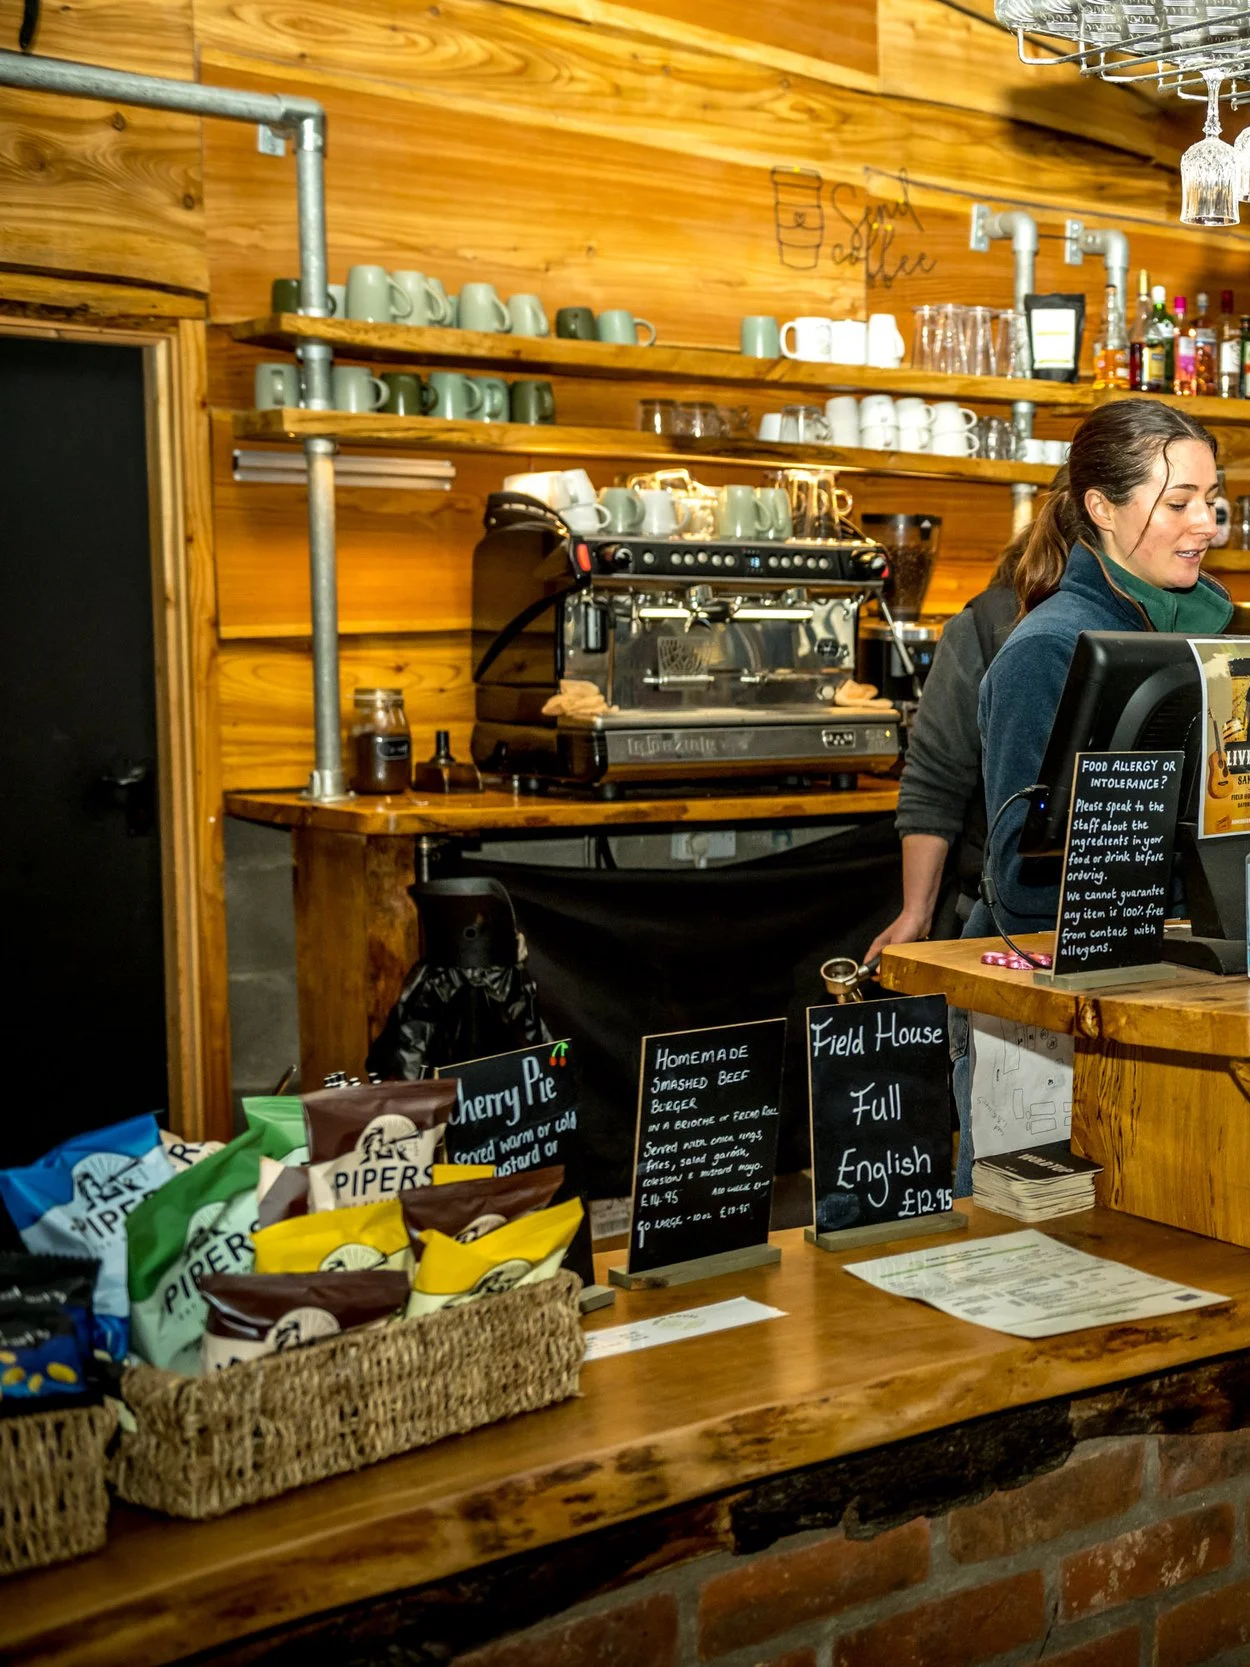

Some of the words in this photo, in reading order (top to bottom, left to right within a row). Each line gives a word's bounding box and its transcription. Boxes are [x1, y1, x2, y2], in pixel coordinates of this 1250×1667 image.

[831, 226, 937, 289] coffee
[1082, 760, 1108, 773] FOOD
[1112, 760, 1158, 772] ALLERGY
[1163, 761, 1176, 772] OR
[1091, 775, 1168, 790] INTOLERANCE?
[1075, 799, 1103, 813] Please
[1106, 800, 1132, 818] speak
[1135, 800, 1144, 812] to
[1149, 801, 1165, 812] the
[1073, 818, 1100, 833] staff
[1101, 821, 1128, 831] about
[1132, 820, 1149, 831] the
[1071, 835, 1129, 853] ingredients
[1133, 835, 1141, 845] in
[1141, 836, 1164, 851] your
[1069, 851, 1090, 866] food
[1093, 855, 1102, 864] or
[1105, 850, 1131, 863] drink
[1135, 849, 1164, 866] before
[1067, 867, 1108, 885] ordering.
[1067, 891, 1081, 901] We
[1085, 888, 1117, 900] cannot
[1117, 884, 1165, 906] guarantee
[1064, 911, 1081, 926] any
[1083, 908, 1105, 919] item
[1109, 906, 1118, 917] is
[1145, 903, 1164, 918] free
[1061, 928, 1086, 944] from
[1090, 926, 1128, 938] contact
[1134, 922, 1156, 935] with
[1061, 942, 1113, 961] allergens.
[810, 1017, 865, 1057] Field
[875, 1011, 944, 1051] House
[655, 1044, 749, 1071] HOMEMADE
[449, 1078, 521, 1126] herry
[522, 1055, 557, 1106] Pie
[650, 1076, 709, 1094] SMASHED
[717, 1069, 751, 1086] BEEF
[650, 1097, 698, 1114] BURGER
[850, 1082, 902, 1126] Full
[499, 1128, 534, 1154] warm
[537, 1122, 551, 1138] or
[555, 1110, 577, 1134] cold
[648, 1123, 661, 1133] IN
[662, 1121, 670, 1131] A
[674, 1115, 716, 1130] BRIOCHE
[544, 1140, 559, 1157] or
[643, 1141, 679, 1158] Served
[683, 1138, 708, 1151] with
[710, 1135, 735, 1148] onion
[646, 1159, 676, 1173] fries,
[680, 1153, 707, 1167] salad
[700, 1164, 733, 1178] mustard
[737, 1162, 763, 1178] mayo.
[836, 1145, 932, 1208] English
[897, 1188, 953, 1217] £12.95
